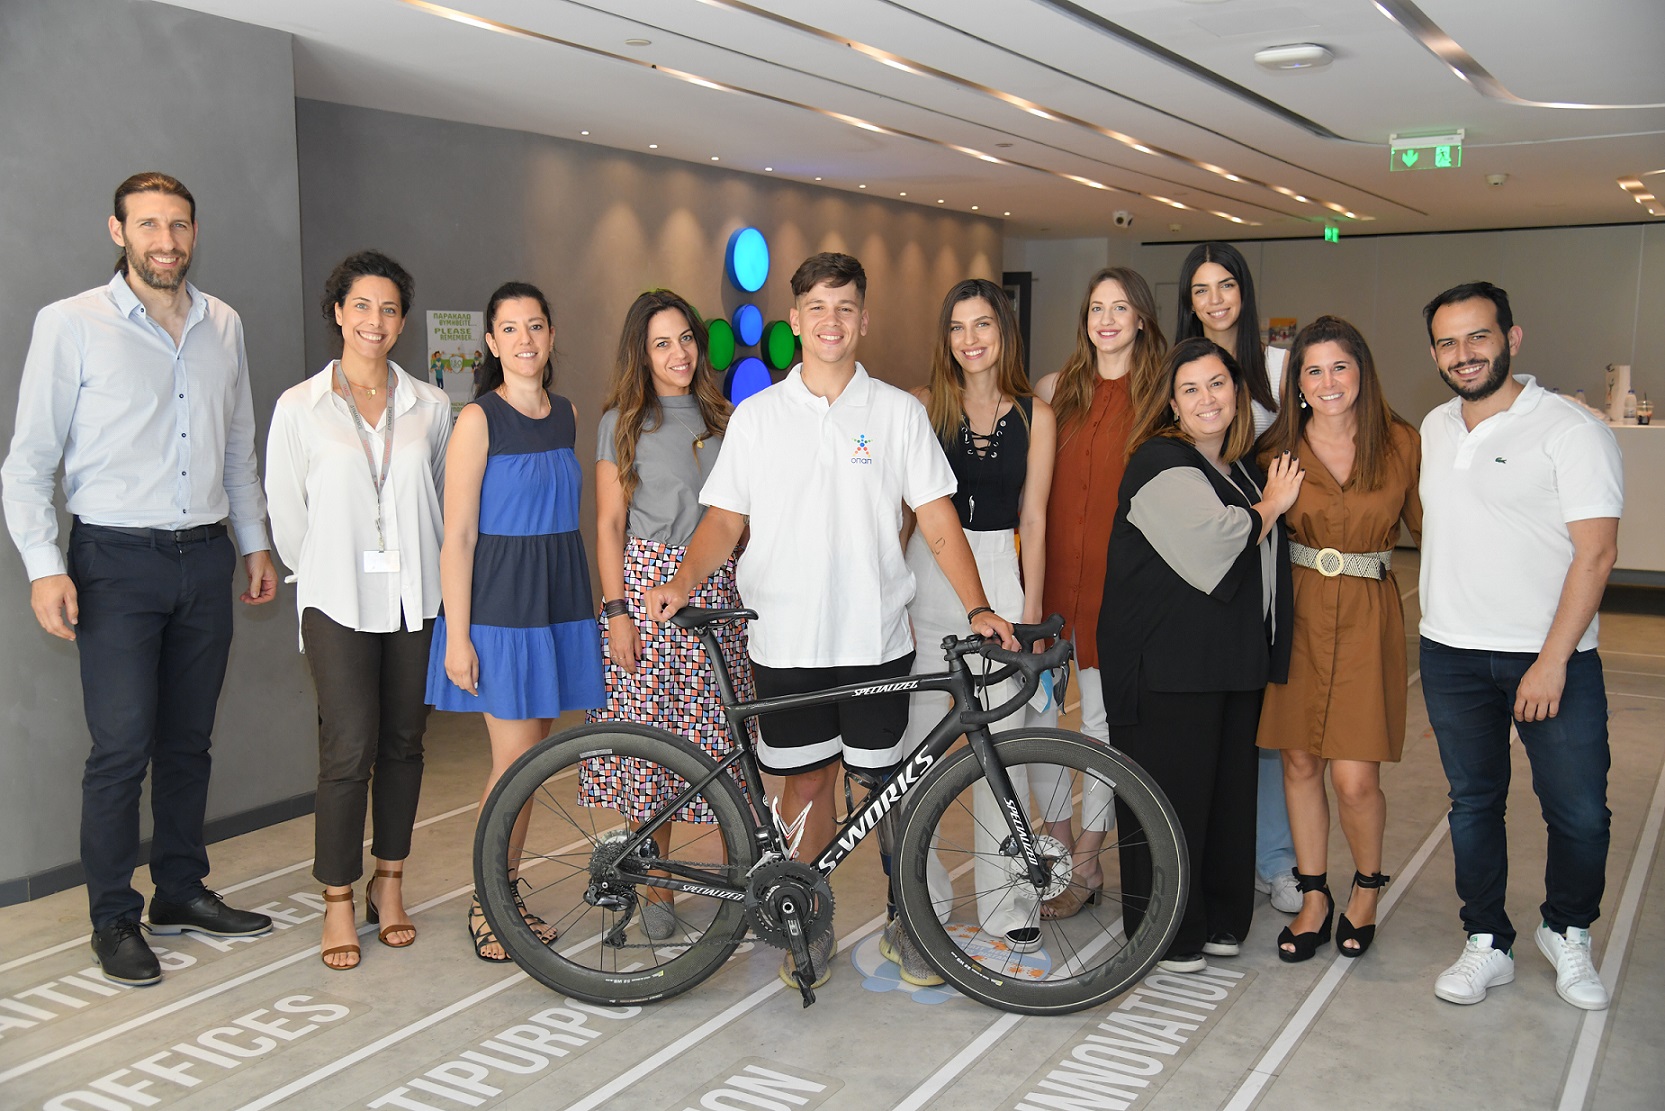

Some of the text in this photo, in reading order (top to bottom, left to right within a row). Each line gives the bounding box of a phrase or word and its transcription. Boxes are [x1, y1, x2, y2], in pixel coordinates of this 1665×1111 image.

[434, 327, 472, 335] PLEASE
[817, 744, 934, 878] S-WORKS
[1003, 797, 1039, 866] SPECIALIZED
[682, 884, 745, 901] SPECIALIZED
